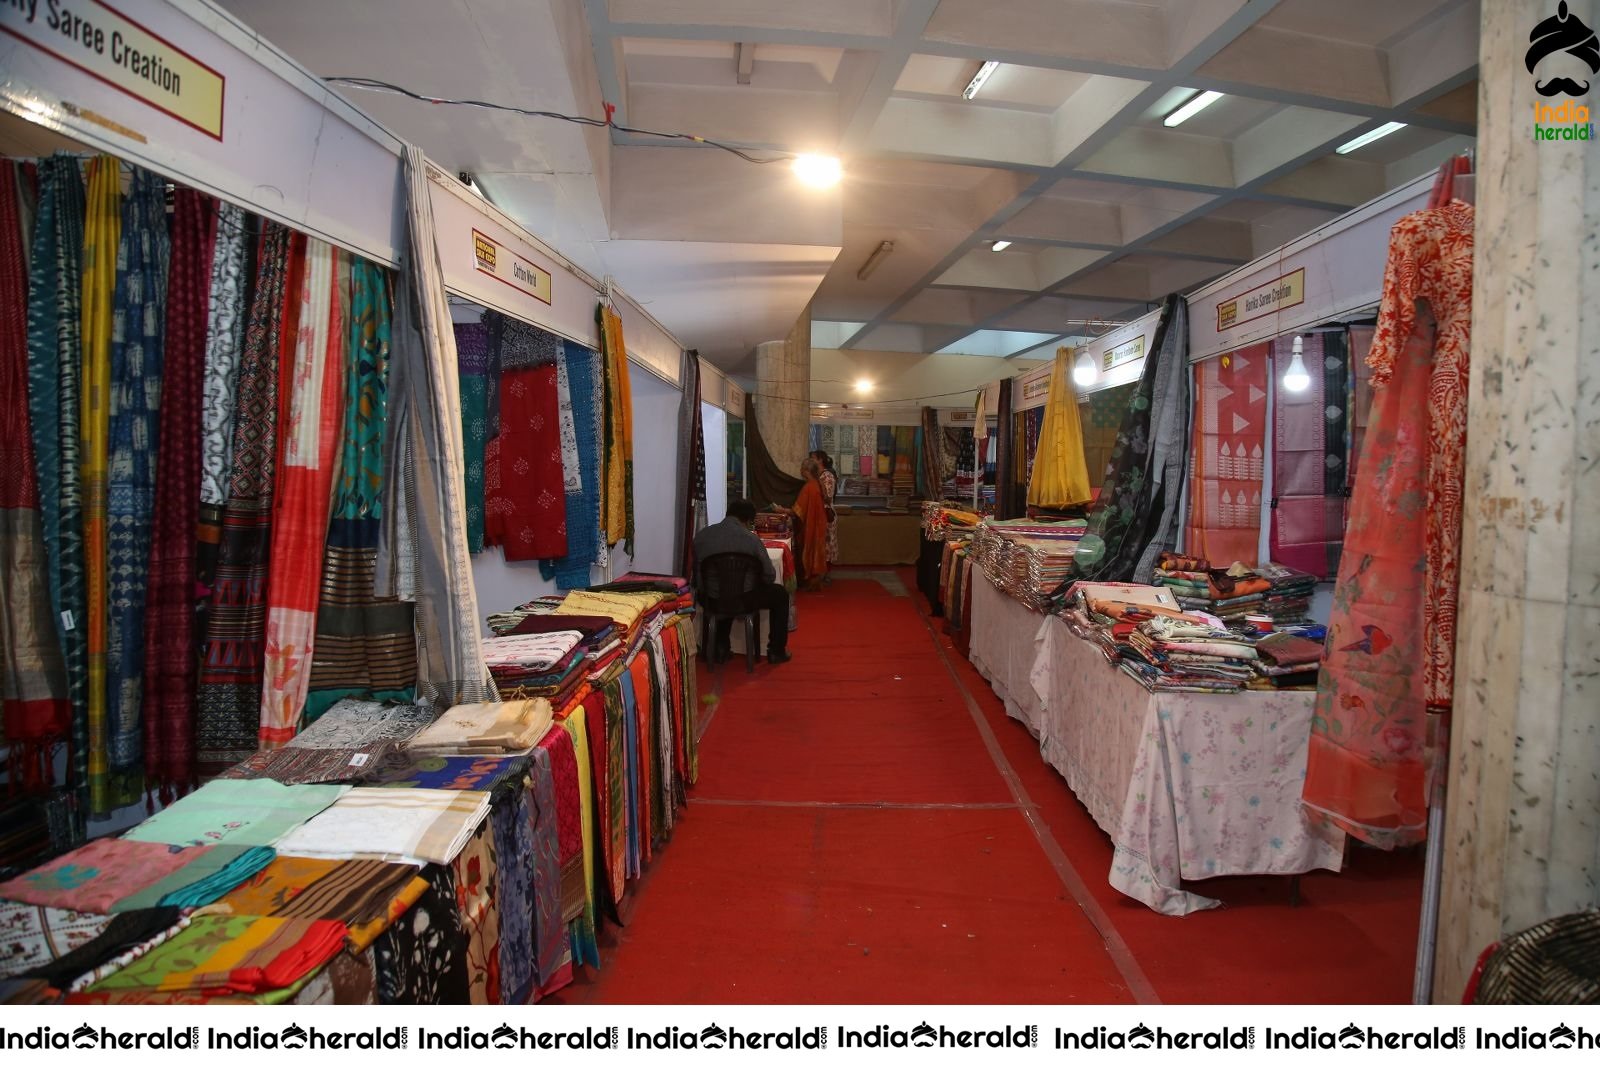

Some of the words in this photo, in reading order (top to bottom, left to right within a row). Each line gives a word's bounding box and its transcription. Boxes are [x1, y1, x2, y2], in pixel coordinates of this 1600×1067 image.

[47, 0, 104, 55] Saree
[112, 31, 181, 97] Creation
[513, 262, 526, 281] Cotton
[527, 269, 537, 287] World
[1259, 292, 1271, 308] Saree
[1272, 284, 1291, 302] Creation
